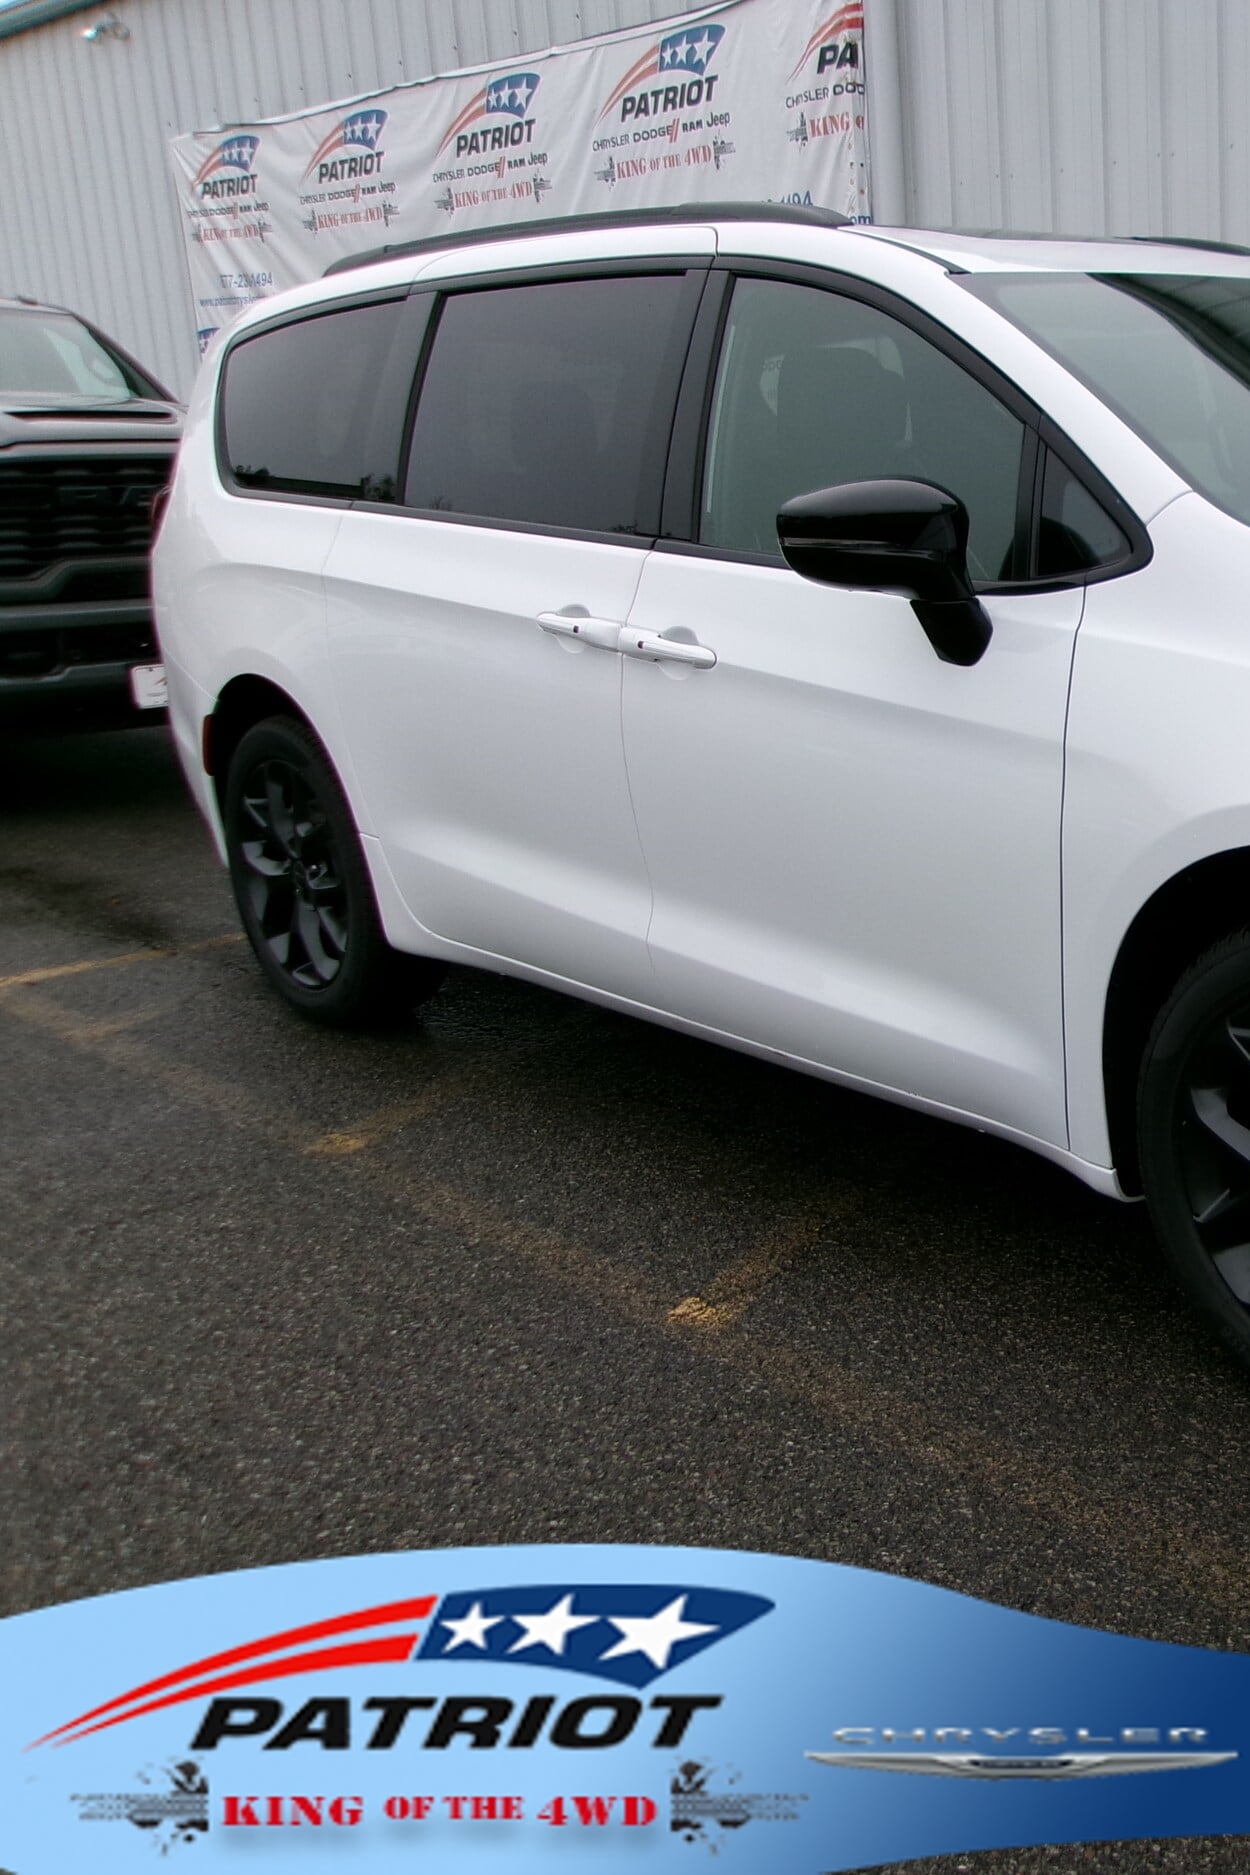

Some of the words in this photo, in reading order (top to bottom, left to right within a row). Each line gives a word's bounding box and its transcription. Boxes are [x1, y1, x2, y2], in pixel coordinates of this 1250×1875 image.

[620, 74, 718, 122] PATRIOT
[456, 118, 536, 158] PATRIOT
[592, 134, 630, 152] CHRYSLER
[632, 126, 674, 143] DODGE
[682, 119, 703, 133] RAM
[706, 112, 730, 128] Jeep
[810, 112, 850, 138] KING
[318, 150, 384, 184] PATRIOT
[467, 162, 500, 177] DODGE
[507, 158, 526, 170] RAM
[528, 152, 548, 166] Jeep
[617, 158, 646, 179] KING
[650, 158, 661, 171] OF
[663, 154, 681, 168] THE
[684, 145, 712, 166] 4WD
[201, 174, 258, 199] PATRIOT
[327, 188, 357, 201] DODGE
[454, 190, 479, 208] KING
[490, 188, 507, 200] THE
[511, 181, 532, 199] 4WD
